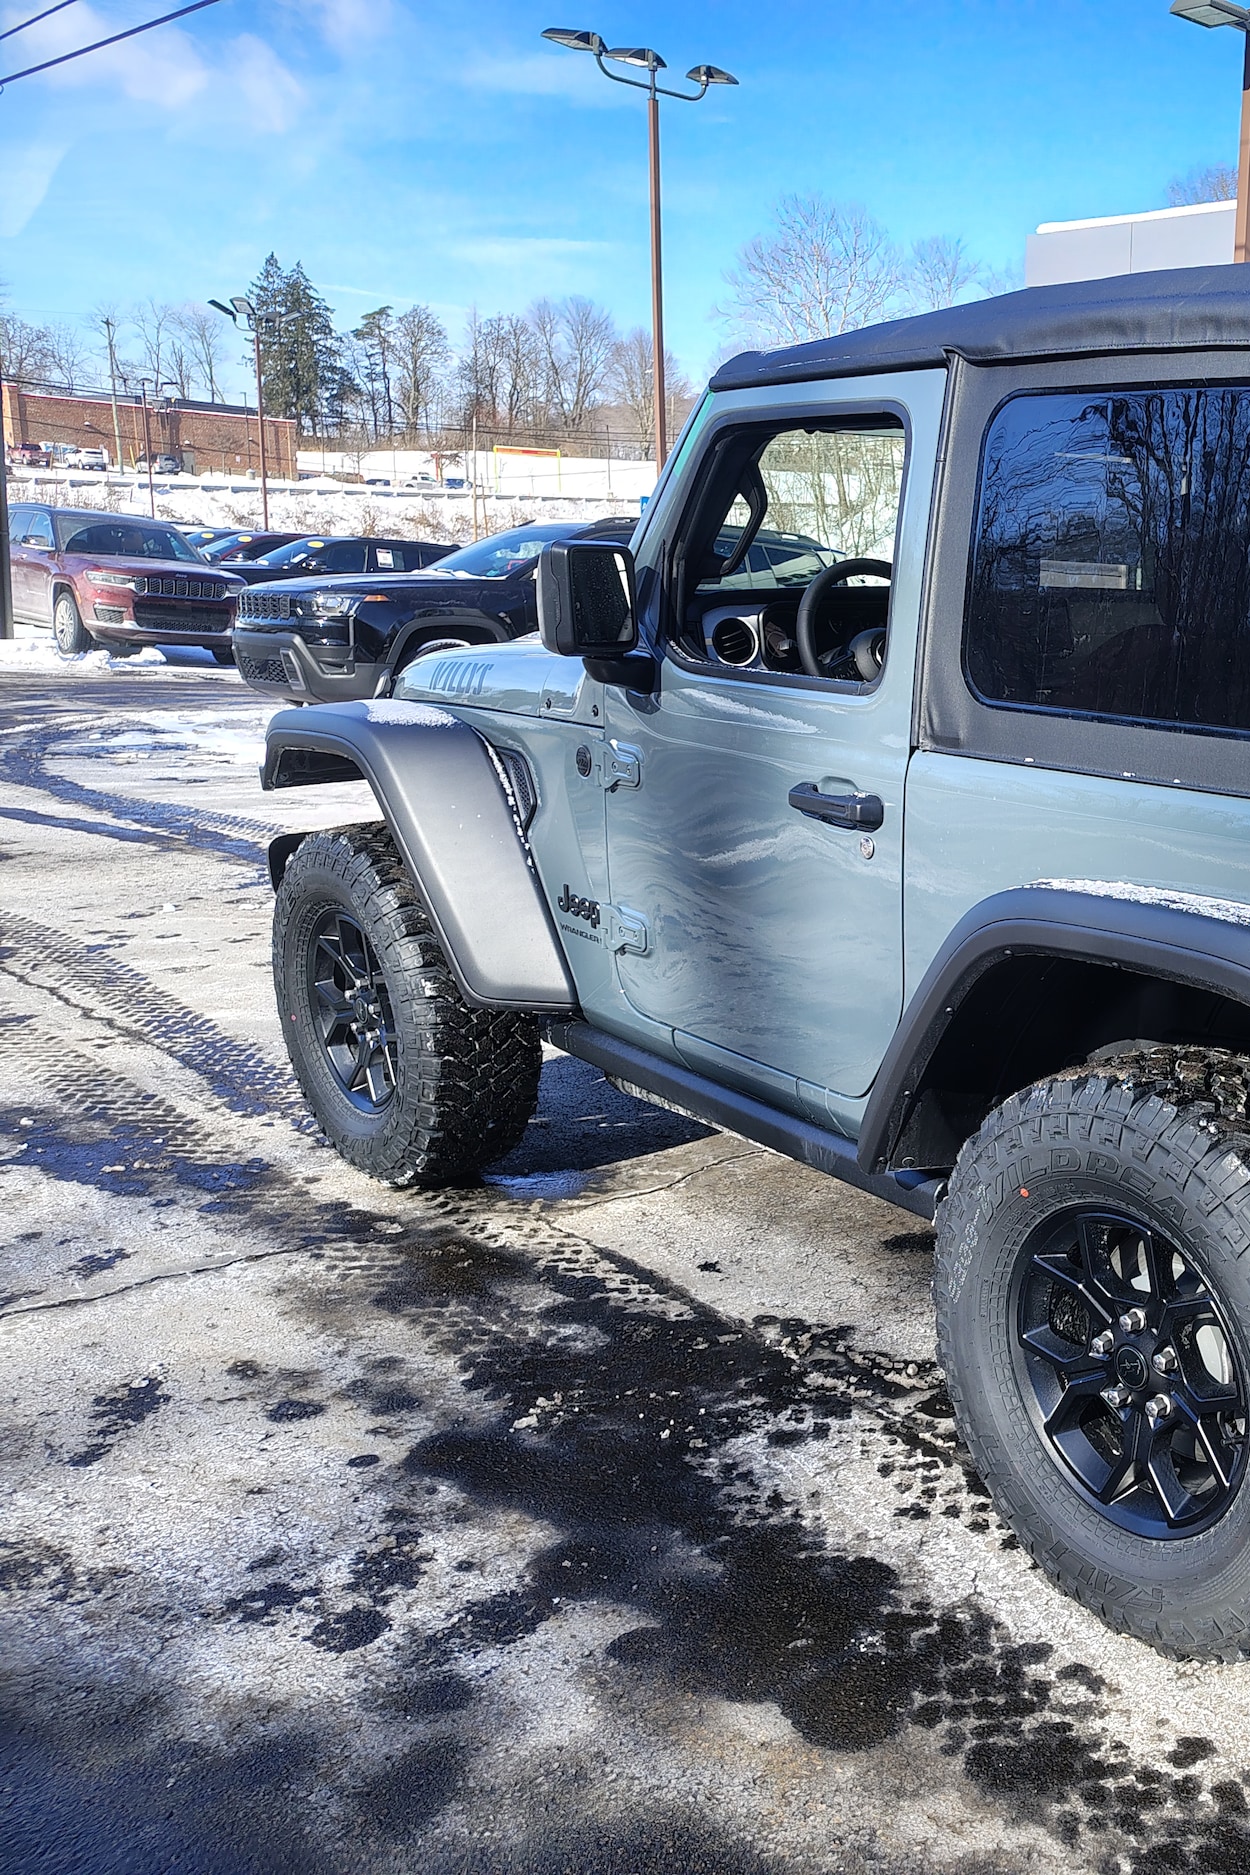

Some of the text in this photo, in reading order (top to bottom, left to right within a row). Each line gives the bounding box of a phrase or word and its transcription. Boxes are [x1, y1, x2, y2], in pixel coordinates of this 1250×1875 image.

[558, 884, 600, 929] Jeep
[560, 922, 600, 944] WRANGLER
[983, 1145, 1227, 1266] WILDPEAK
